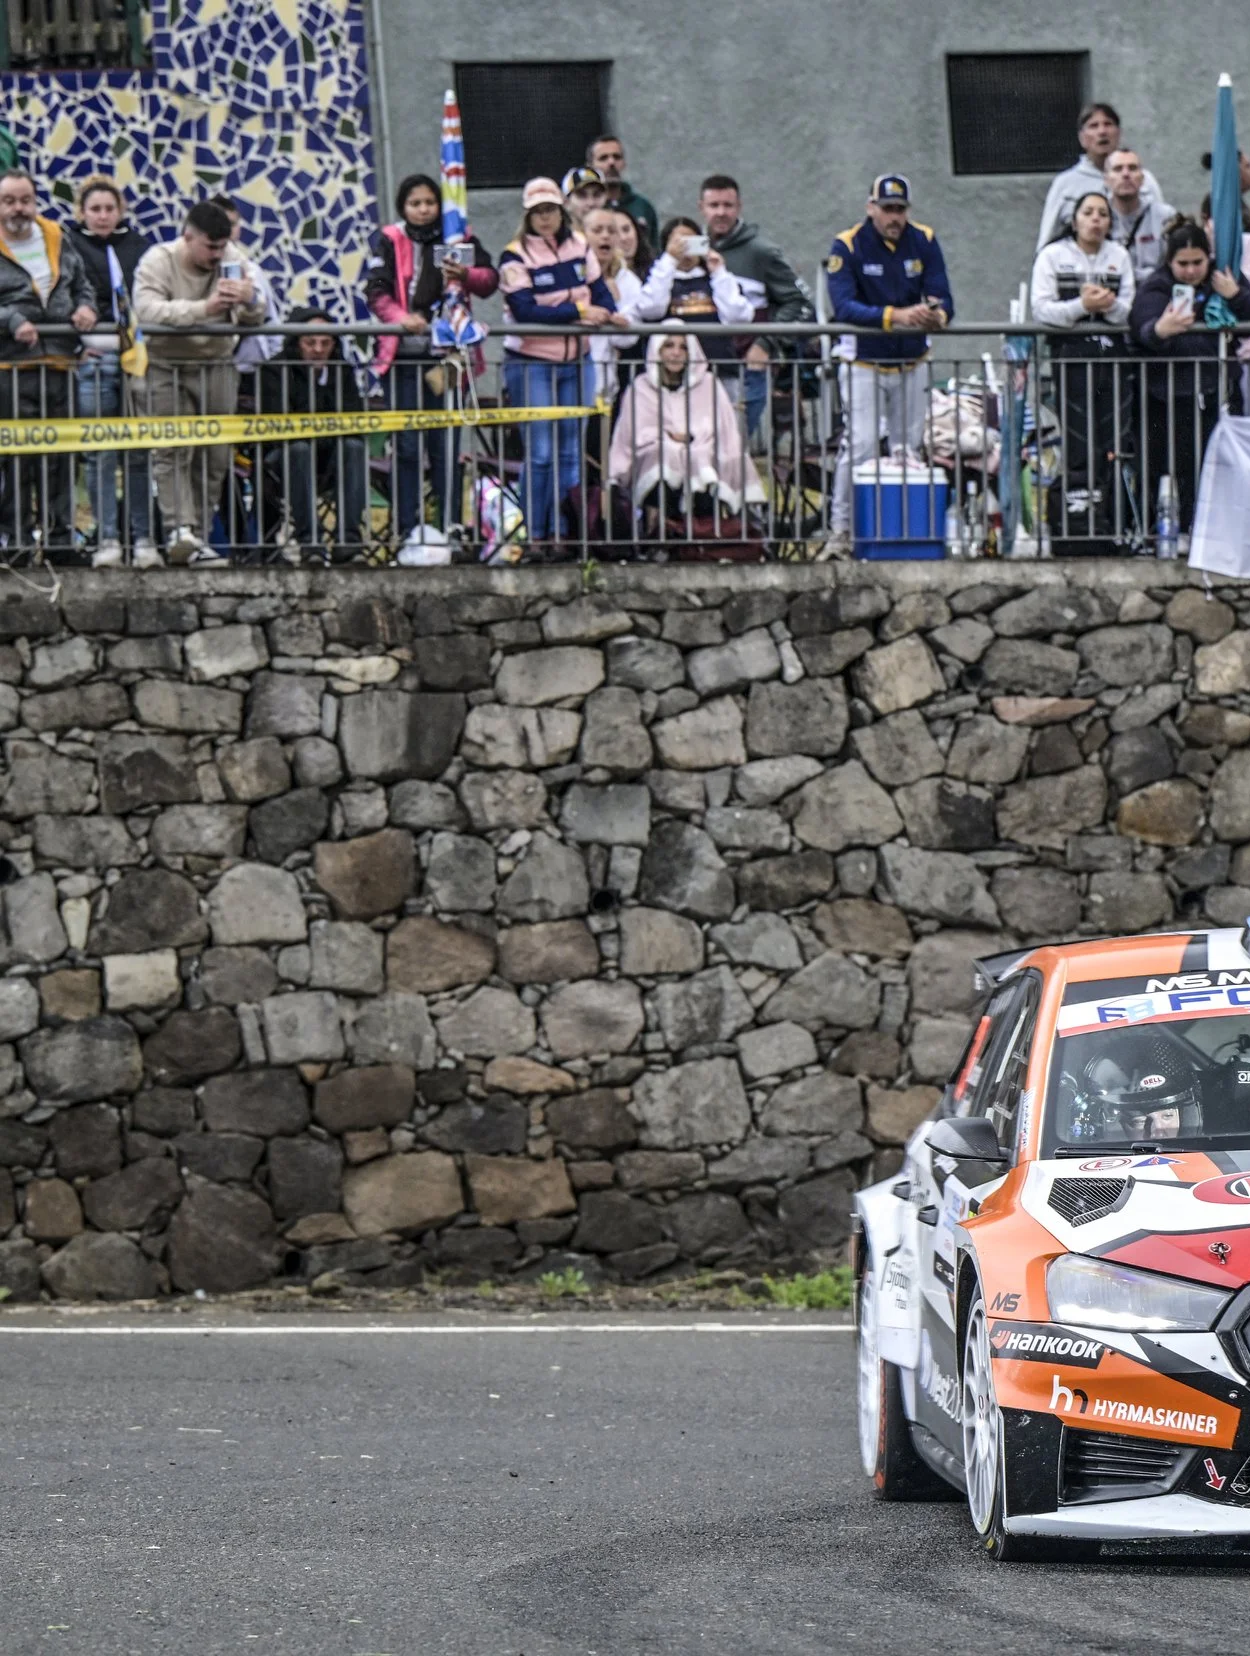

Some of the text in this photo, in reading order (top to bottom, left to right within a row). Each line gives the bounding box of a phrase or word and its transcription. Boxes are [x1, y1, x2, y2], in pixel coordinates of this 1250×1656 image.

[80, 422, 132, 443] ZONA
[243, 418, 295, 436] ZONA
[1145, 974, 1212, 993] MS
[1143, 1077, 1162, 1085] BELL
[989, 1292, 1022, 1313] MS
[1093, 1398, 1218, 1435] HYRMASKINER
